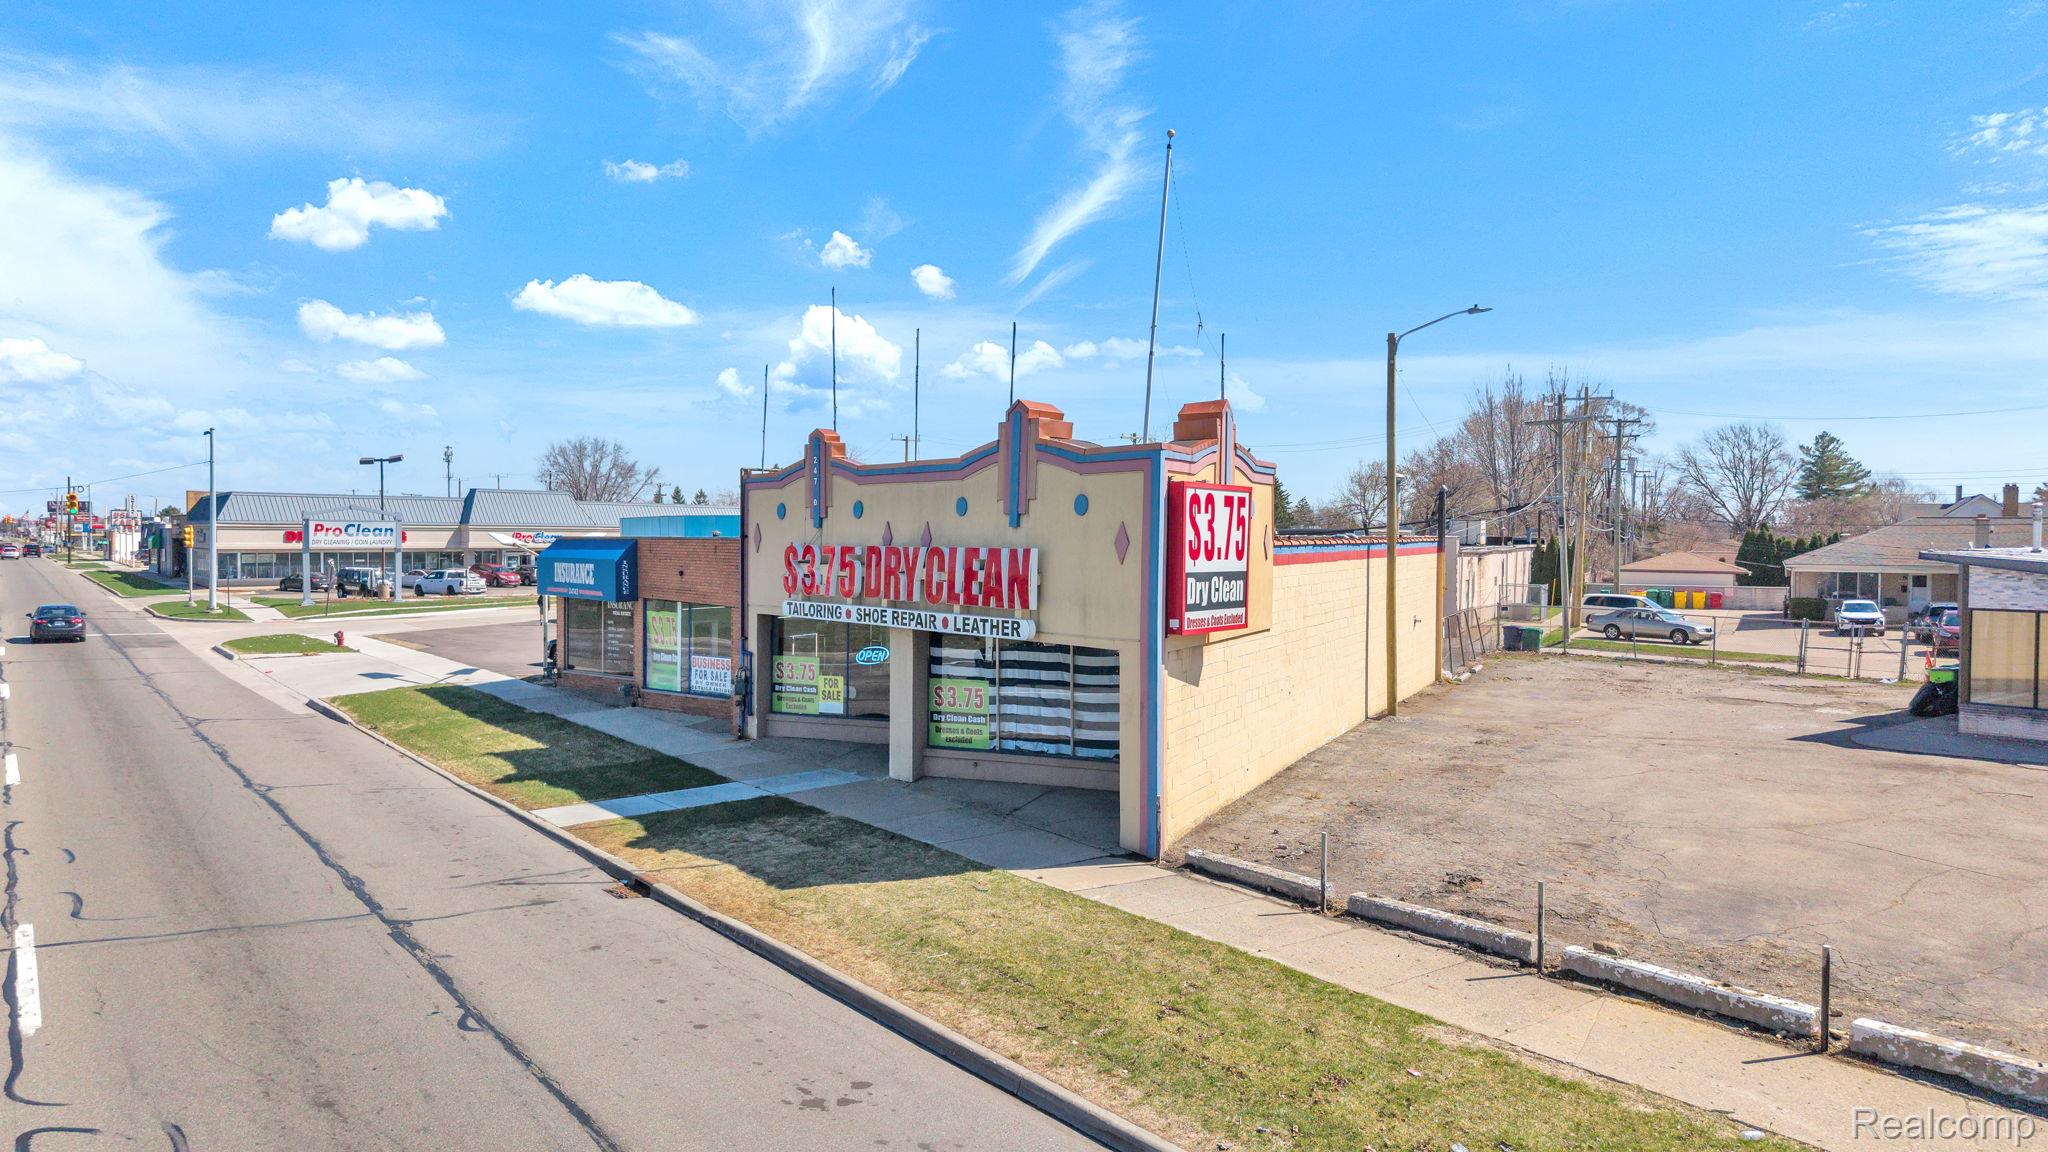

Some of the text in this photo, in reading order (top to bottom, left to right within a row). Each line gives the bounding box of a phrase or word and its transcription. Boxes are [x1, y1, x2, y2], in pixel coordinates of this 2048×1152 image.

[1188, 489, 1247, 567] $3.75
[554, 562, 595, 585] INSURANCE
[783, 542, 862, 599] $3.75
[1187, 576, 1244, 606] Dry Clean
[787, 602, 1021, 637] TAILORING SHOE REPAIR LEATHER
[1187, 612, 1244, 629] Dresses & Coats Excluded
[692, 657, 731, 671] BUSINESS
[858, 650, 885, 661] OPEN
[694, 669, 728, 683] FOR SALE
[776, 661, 815, 681] $3.75
[823, 678, 839, 689] FOR
[821, 689, 841, 701] SALE
[933, 685, 985, 710] $3.75
[933, 714, 946, 722] Dry
[968, 716, 986, 724] Cash
